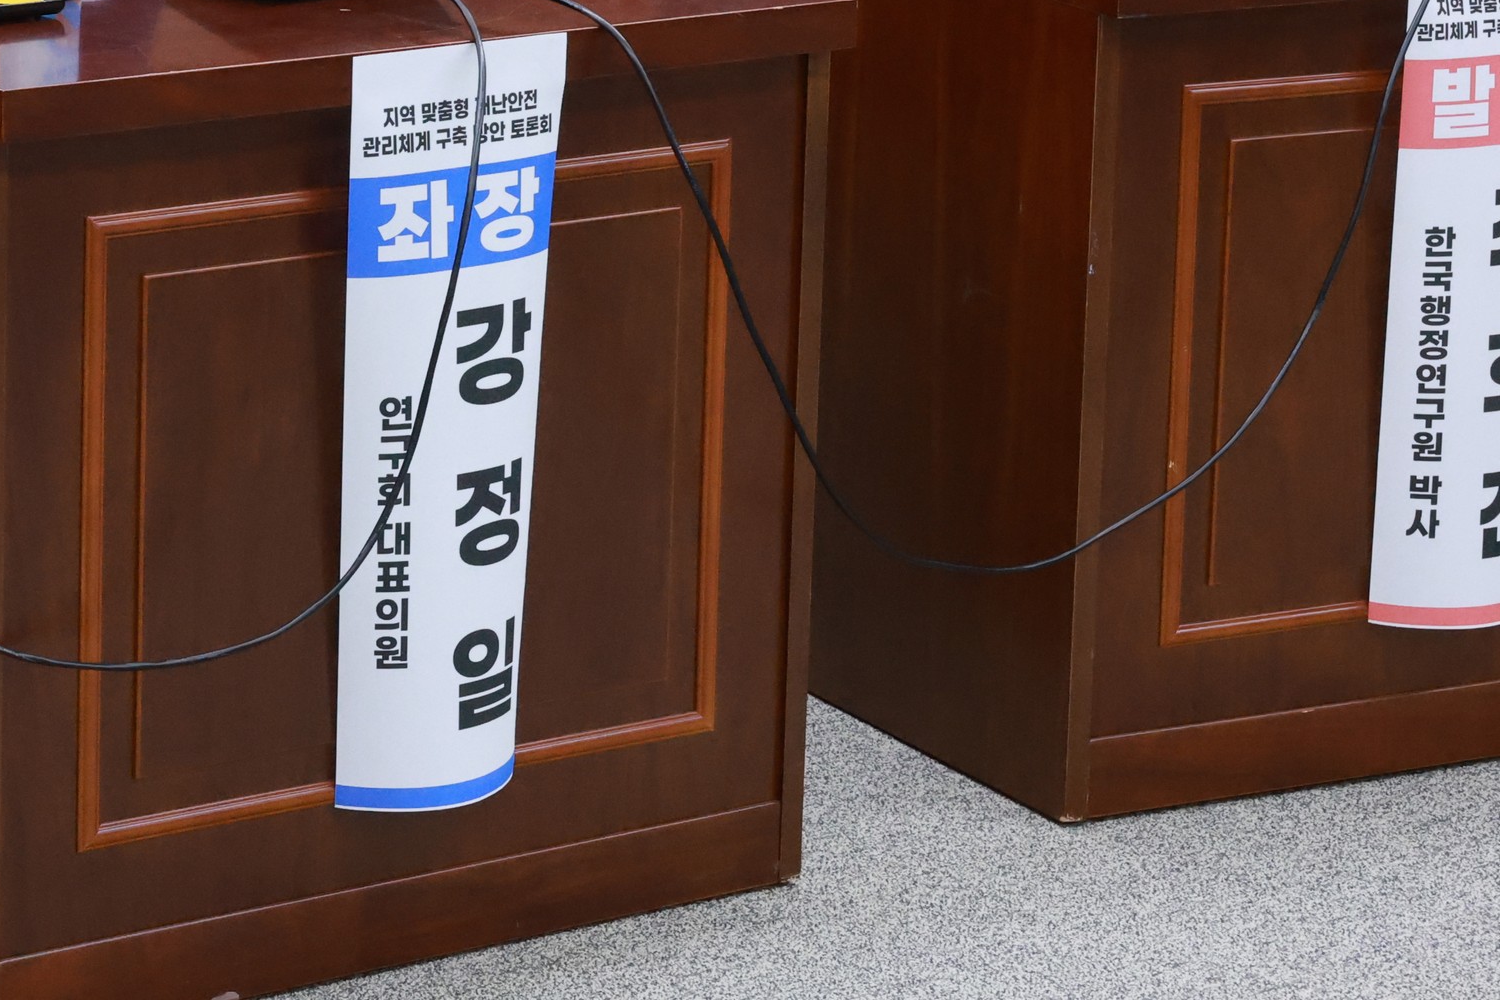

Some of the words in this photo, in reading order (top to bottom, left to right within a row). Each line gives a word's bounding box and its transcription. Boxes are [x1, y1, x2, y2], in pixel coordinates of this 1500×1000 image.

[1416, 20, 1478, 43] 관리체계
[362, 131, 431, 158] 관리체계
[436, 125, 468, 150] 구축
[510, 113, 552, 139] 토론회
[383, 104, 416, 128] 지역
[421, 97, 469, 125] 맞춤형
[1410, 224, 1457, 463] 한국행정연구원
[1405, 473, 1443, 540] 박사
[373, 520, 412, 670] 대표의원
